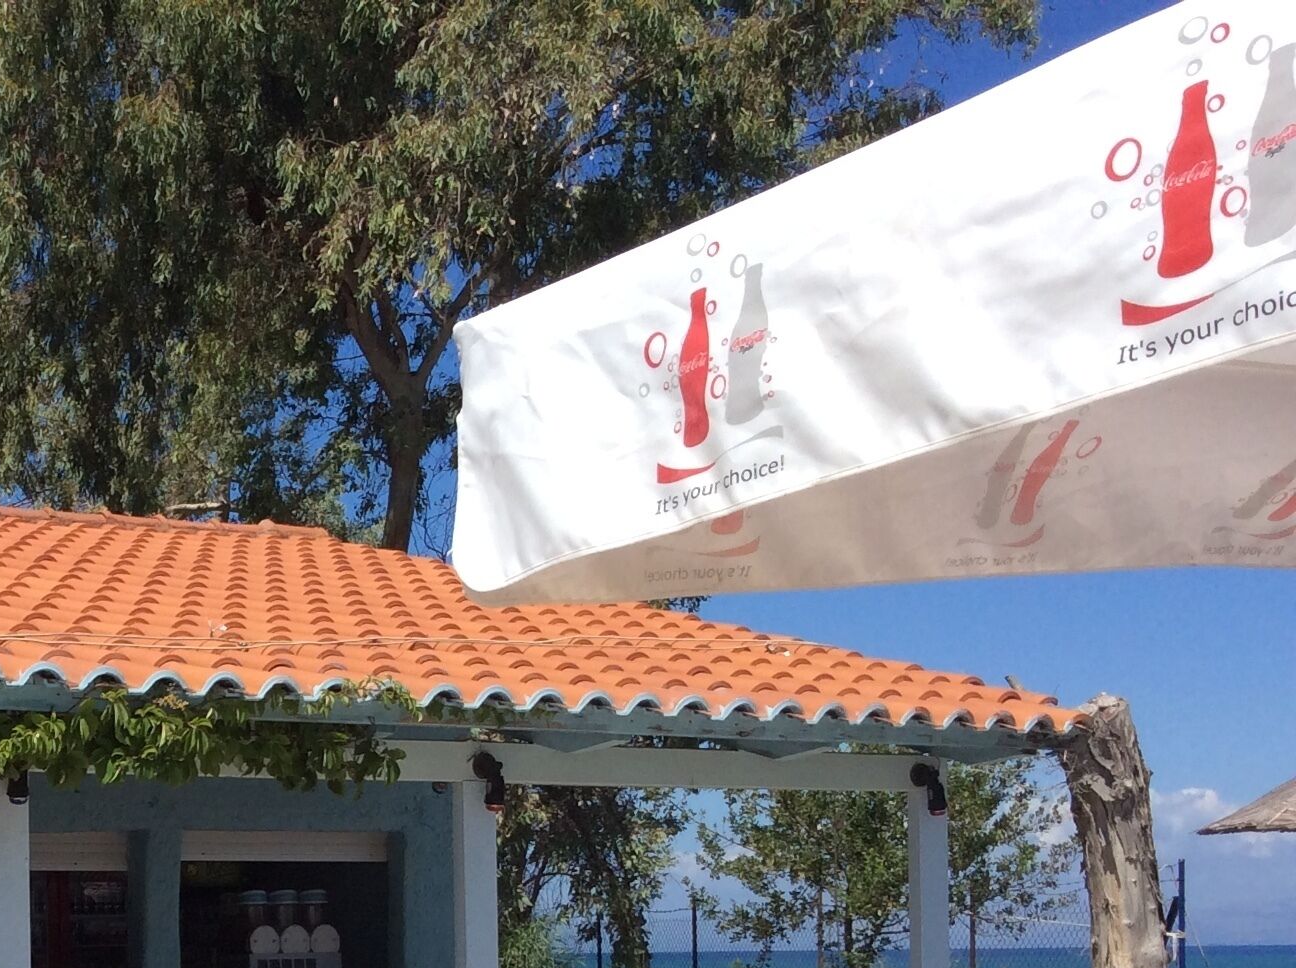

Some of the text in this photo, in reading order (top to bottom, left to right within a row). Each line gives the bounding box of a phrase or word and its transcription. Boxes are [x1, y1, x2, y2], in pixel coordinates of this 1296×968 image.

[1116, 339, 1157, 365] It's
[1165, 316, 1225, 355] your
[655, 454, 785, 515] It's your choice!
